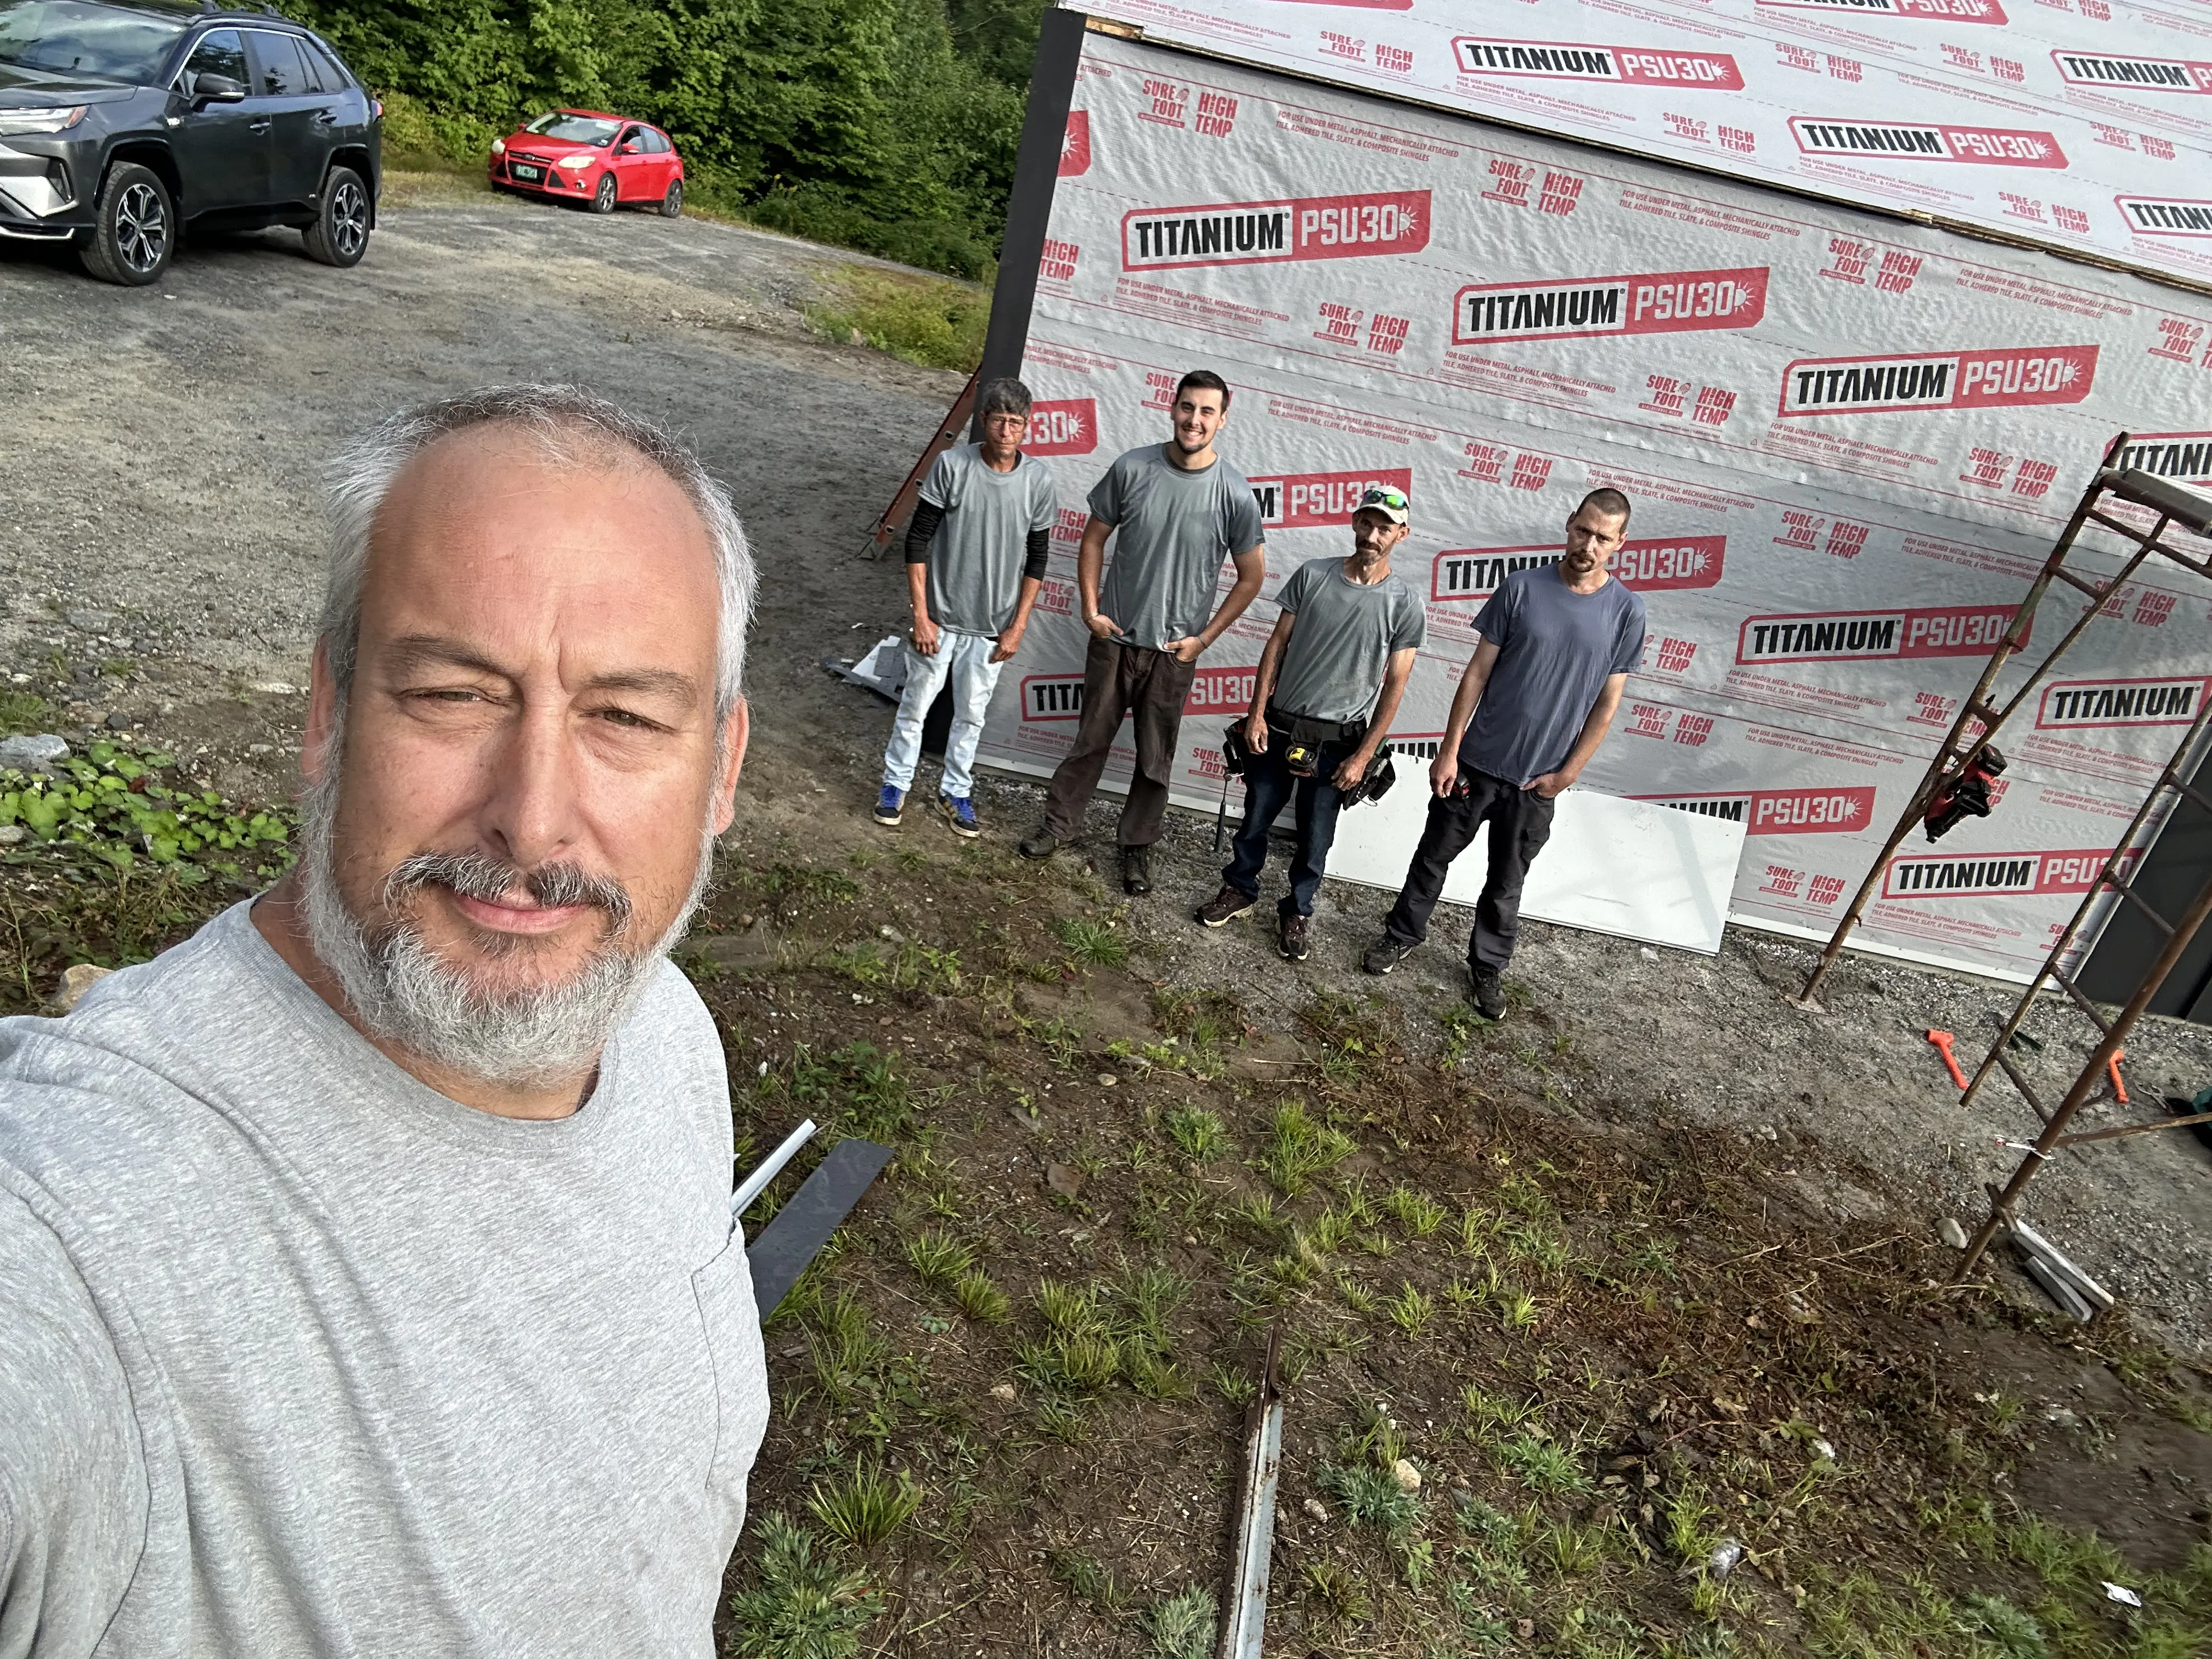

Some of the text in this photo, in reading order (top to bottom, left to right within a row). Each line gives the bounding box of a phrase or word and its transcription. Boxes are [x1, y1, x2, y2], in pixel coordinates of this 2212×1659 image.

[1320, 30, 1352, 44] SURE
[1331, 42, 1362, 58] FOOT
[1775, 43, 1805, 58] SURE
[1940, 43, 1968, 57] SURE
[1376, 56, 1412, 73] TEMP
[1465, 44, 1715, 81] TITANIUM PSU30
[1788, 55, 1816, 69] FOOT
[1953, 54, 1980, 68] FOOT
[1830, 66, 1863, 83] TEMP
[1992, 68, 2025, 83] TEMP
[2064, 57, 2191, 87] TITANIUM
[1142, 80, 1176, 101] SURE
[1152, 98, 1183, 119] FOOT
[1195, 116, 1233, 138] TEMP
[1663, 112, 1694, 127] SURE
[1278, 110, 1291, 119] FOR
[1291, 113, 1304, 122] USE
[1304, 116, 1326, 127] UNDER
[1427, 144, 1459, 157] ATTACHED
[1675, 124, 1706, 138] FOOT
[1363, 140, 1398, 155] COMPOSITE
[1399, 149, 1430, 162] SHINGLES
[1719, 137, 1755, 154] TEMP
[1802, 124, 2038, 161] TITANIUM PSU30
[1488, 159, 1523, 182] SURE
[1497, 177, 1529, 198] FOOT
[1538, 192, 1576, 216] TEMP
[1999, 191, 2030, 207] SURE
[2012, 203, 2042, 219] FOOT
[1136, 204, 1400, 257] TITANIUM PSU30
[2055, 217, 2090, 234] TEMP
[1829, 238, 1863, 259] SURE
[1039, 258, 1075, 281] TEMP
[1835, 255, 1867, 275] FOOT
[1875, 271, 1913, 294] TEMP
[1319, 302, 1352, 322] SURE
[1468, 280, 1735, 331] TITANIUM PSU30
[1327, 319, 1358, 338] FOOT
[2158, 318, 2193, 337] SURE
[1368, 332, 1403, 355] TEMP
[2164, 336, 2196, 354] FOOT
[1146, 372, 1177, 391] SURE
[1646, 374, 1678, 393] SURE
[1798, 358, 2064, 404] TITANIUM PSU30
[1154, 388, 1176, 404] FOO
[1653, 390, 1684, 409] FOOT
[1692, 404, 1729, 426] TEMP
[1464, 443, 1496, 461] SURE
[1770, 422, 1782, 430] FOR
[1795, 428, 1816, 438] UNDER
[1909, 454, 1938, 465] ATTACHED
[1847, 449, 1882, 462] COMPOSITE
[1882, 457, 1910, 469] SHINGLES
[1969, 447, 2002, 466] SURE
[1471, 459, 1502, 476] FOOT
[1974, 463, 2005, 482] FOOT
[1510, 472, 1546, 492] TEMP
[2011, 477, 2049, 499] TEMP
[1781, 511, 1814, 528] SURE
[1050, 524, 1083, 543] TEMP
[1787, 526, 1818, 544] FOOT
[1825, 539, 1861, 560] TEMP
[1043, 580, 1065, 595] URE
[1044, 593, 1071, 609] FOOT
[2132, 607, 2168, 627] TEMP
[1753, 614, 2005, 654] TITANIUM PSU30
[1656, 653, 1690, 673] TEMP
[1752, 674, 1770, 683] UNDER
[1858, 697, 1887, 708] ATTACHED
[1915, 692, 1946, 709] SURE
[1802, 693, 1833, 704] COMPOSITE
[1833, 699, 1861, 710] SHINGLES
[2055, 686, 2194, 720] TITANIUM
[1631, 704, 1661, 720] SURE
[1921, 706, 1950, 722] FOOT
[1637, 716, 1666, 733] FOOT
[1673, 729, 1707, 748] TEMP
[1192, 747, 1220, 762] SURE
[1756, 795, 1844, 825] PSU30
[1766, 865, 1796, 879] SURE
[1899, 859, 2032, 890] TITANIUM
[1772, 877, 1798, 893] FOOT
[1806, 888, 1839, 905] TEMP
